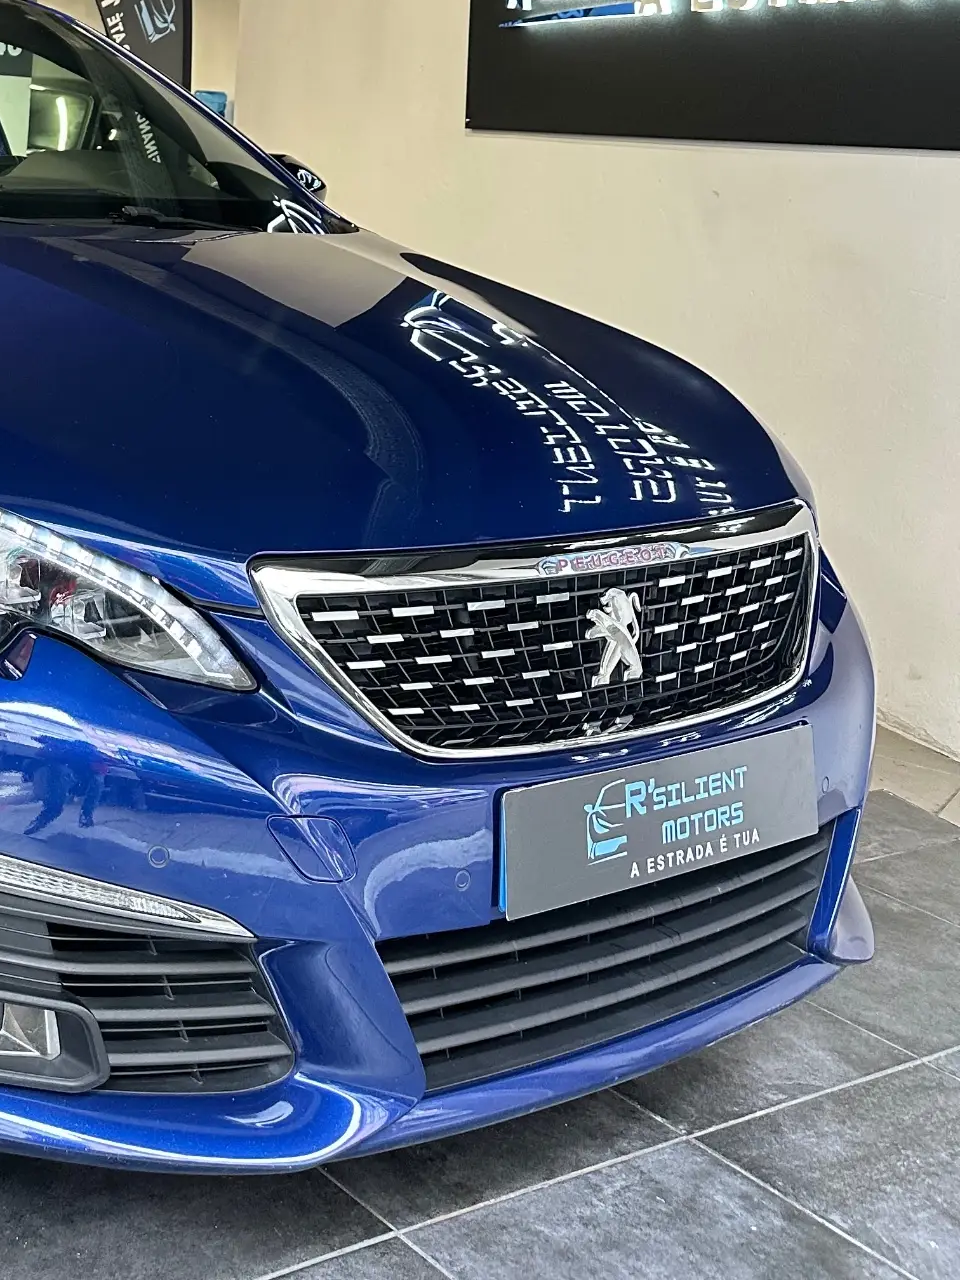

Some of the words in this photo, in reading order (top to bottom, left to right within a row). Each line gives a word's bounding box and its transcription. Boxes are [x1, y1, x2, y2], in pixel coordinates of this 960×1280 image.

[557, 545, 667, 570] PEUGEOT
[625, 766, 748, 819] R'SILIENT
[661, 801, 744, 844] MOTORS
[630, 861, 640, 878] A
[646, 841, 714, 874] ESTRADA
[719, 833, 728, 853] É
[734, 827, 760, 849] TUA
